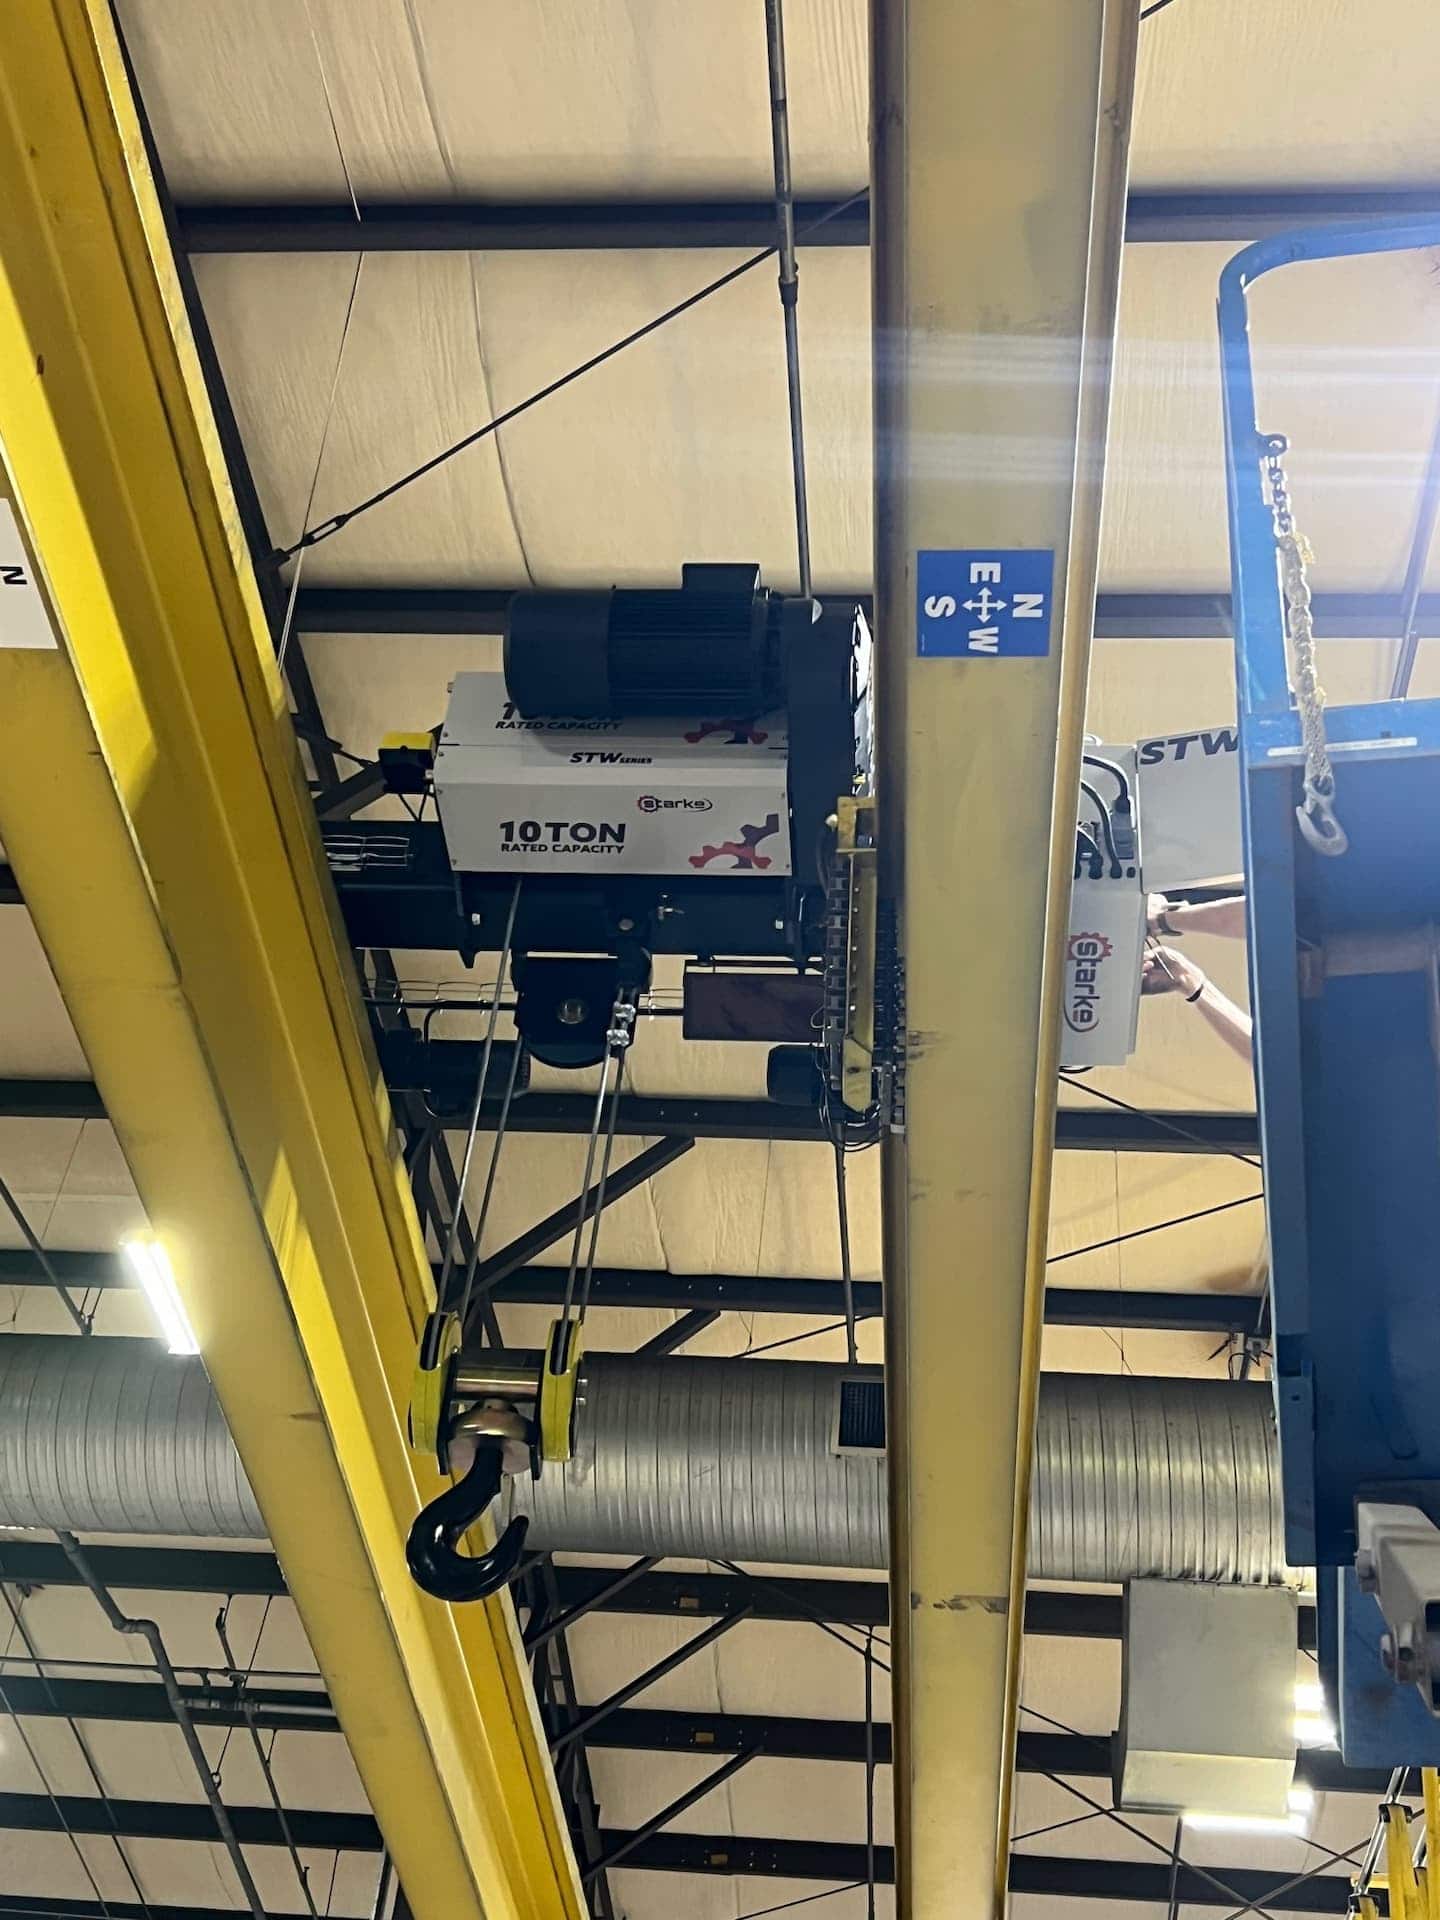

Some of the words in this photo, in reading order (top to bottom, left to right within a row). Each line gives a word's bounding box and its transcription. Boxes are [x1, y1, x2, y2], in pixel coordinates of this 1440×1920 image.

[970, 562, 1001, 584] E
[924, 595, 956, 618] S
[1012, 593, 1044, 618] N
[968, 626, 1000, 653] W
[495, 720, 544, 730] RATED
[547, 720, 623, 731] CAPACITY
[1140, 730, 1239, 765] STW
[500, 820, 541, 842] 10
[545, 822, 626, 843] TON
[501, 843, 548, 853] RATED
[552, 843, 625, 854] CAPACITY
